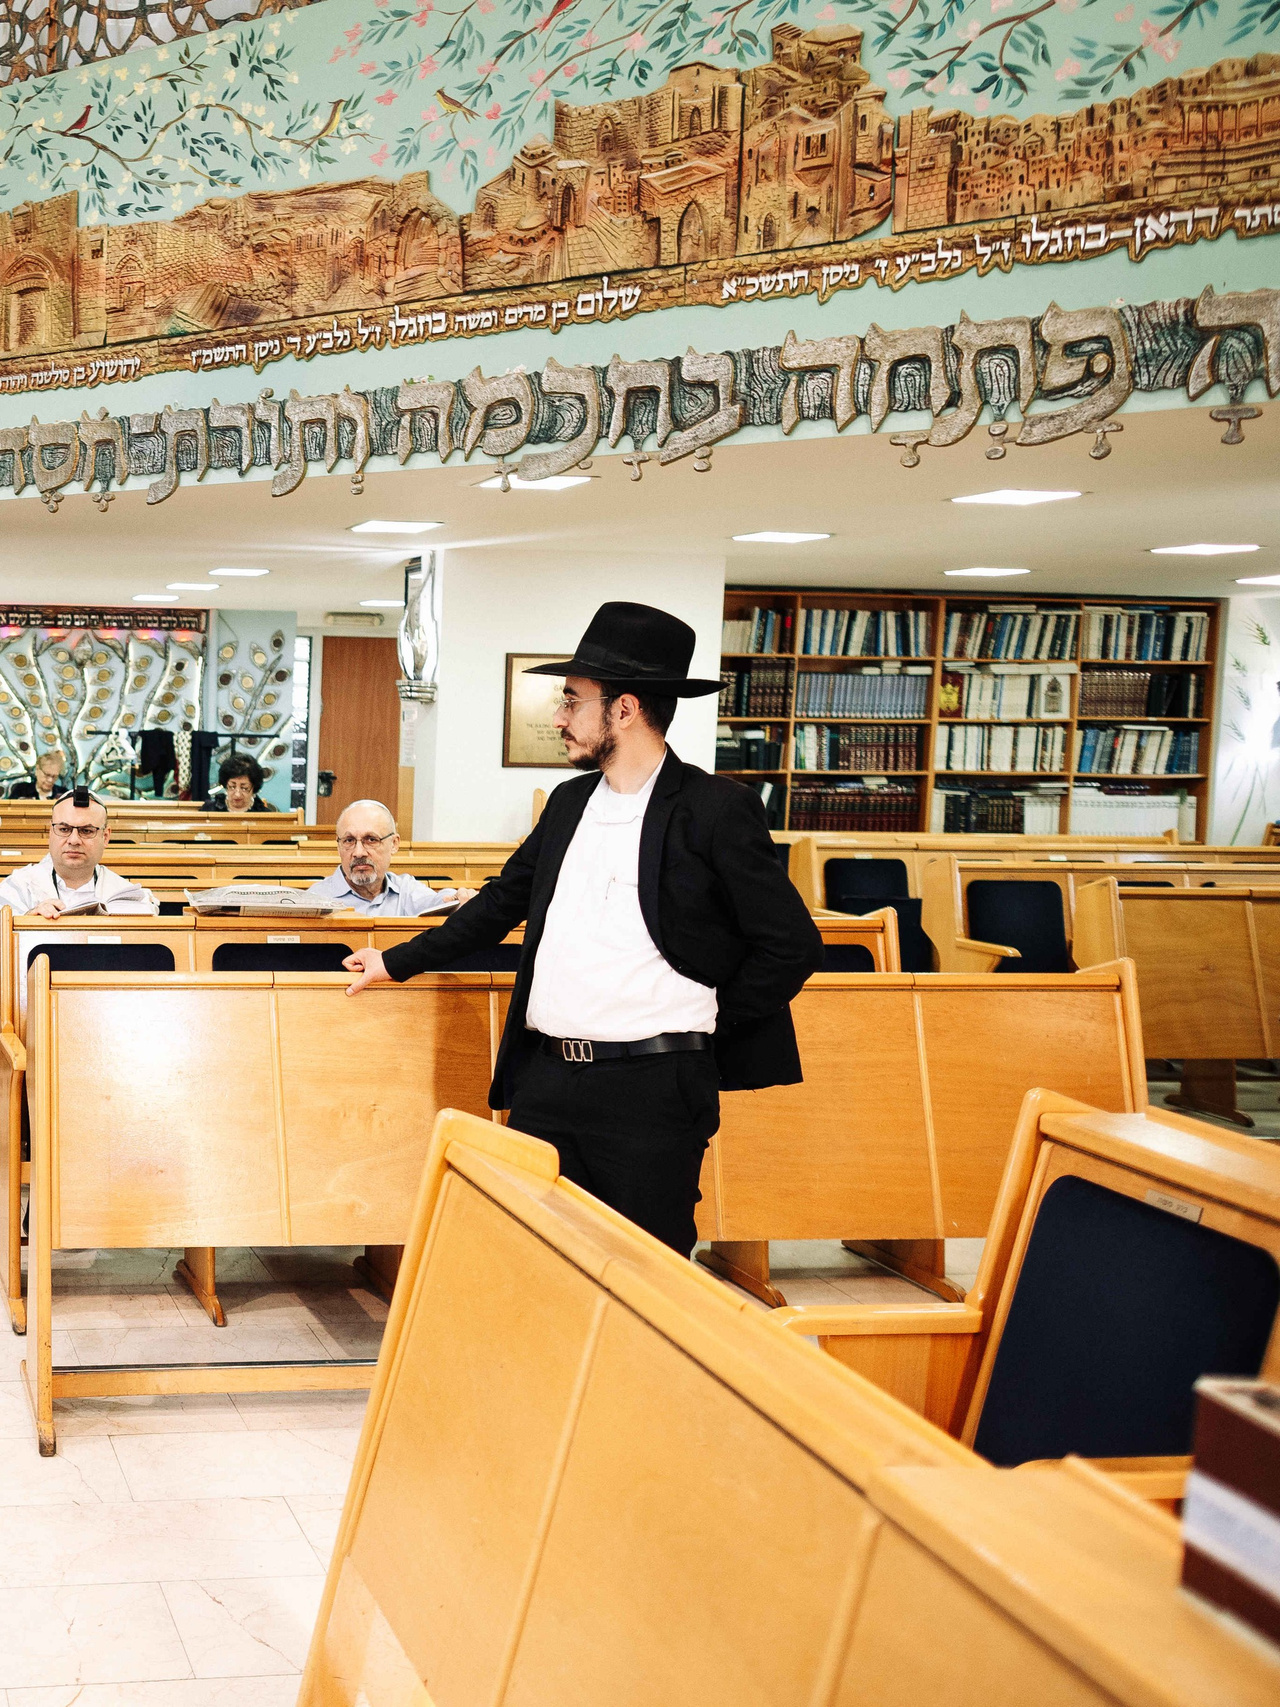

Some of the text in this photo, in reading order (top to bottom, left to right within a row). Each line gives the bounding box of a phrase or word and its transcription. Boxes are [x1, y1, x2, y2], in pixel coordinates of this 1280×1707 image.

[821, 262, 860, 295] ניסן
[576, 276, 642, 316] שלום
[388, 305, 447, 341] בוזגלו
[454, 311, 498, 332] ומשה
[504, 306, 546, 324] מרים
[551, 301, 569, 327] בן
[254, 339, 280, 364] ניסן
[31, 362, 70, 385] סולטנה
[74, 366, 85, 386] בן
[88, 357, 141, 382] יהושוע
